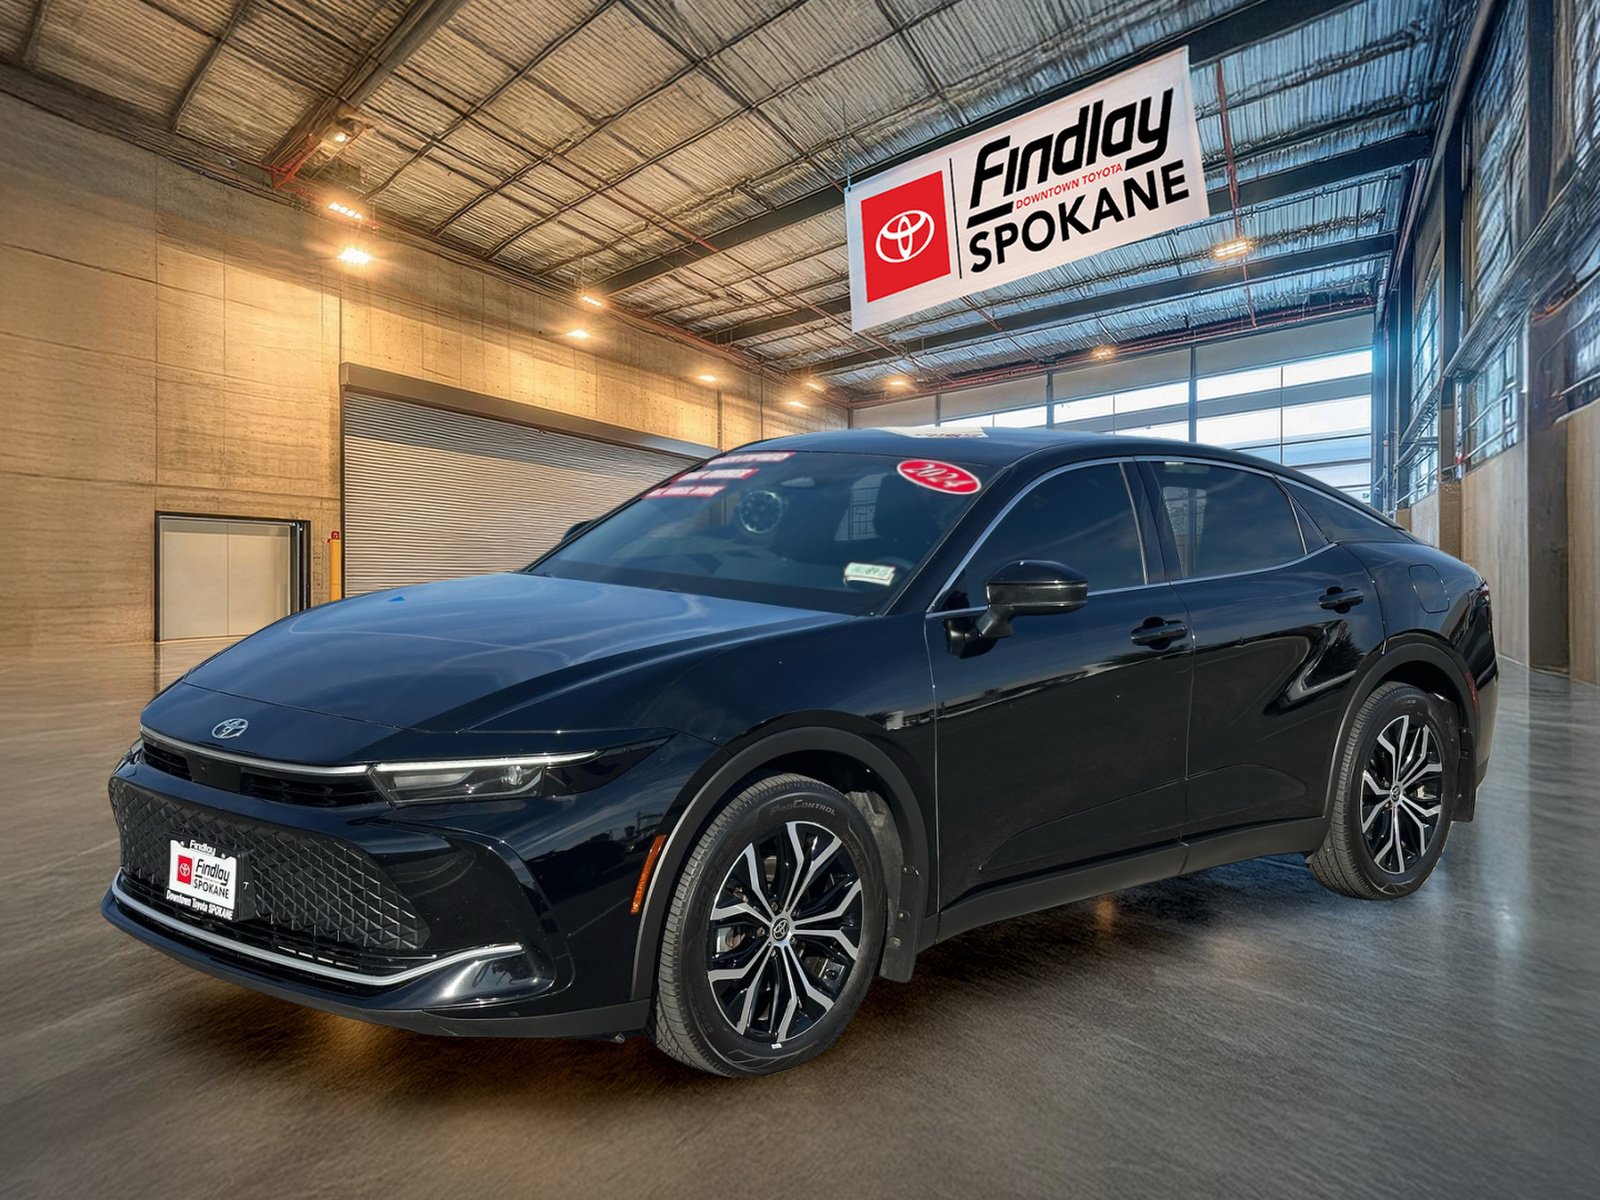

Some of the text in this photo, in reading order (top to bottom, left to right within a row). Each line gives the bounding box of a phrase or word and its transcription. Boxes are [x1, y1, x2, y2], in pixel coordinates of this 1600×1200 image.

[968, 87, 1174, 228] Findlay
[1015, 162, 1123, 210] DOWNTOWN TOYOTA
[969, 159, 1190, 273] SPOKANE
[903, 463, 976, 488] 2024
[190, 840, 216, 857] Findlay
[195, 858, 230, 887] Findlay
[193, 878, 229, 899] SPOKANE
